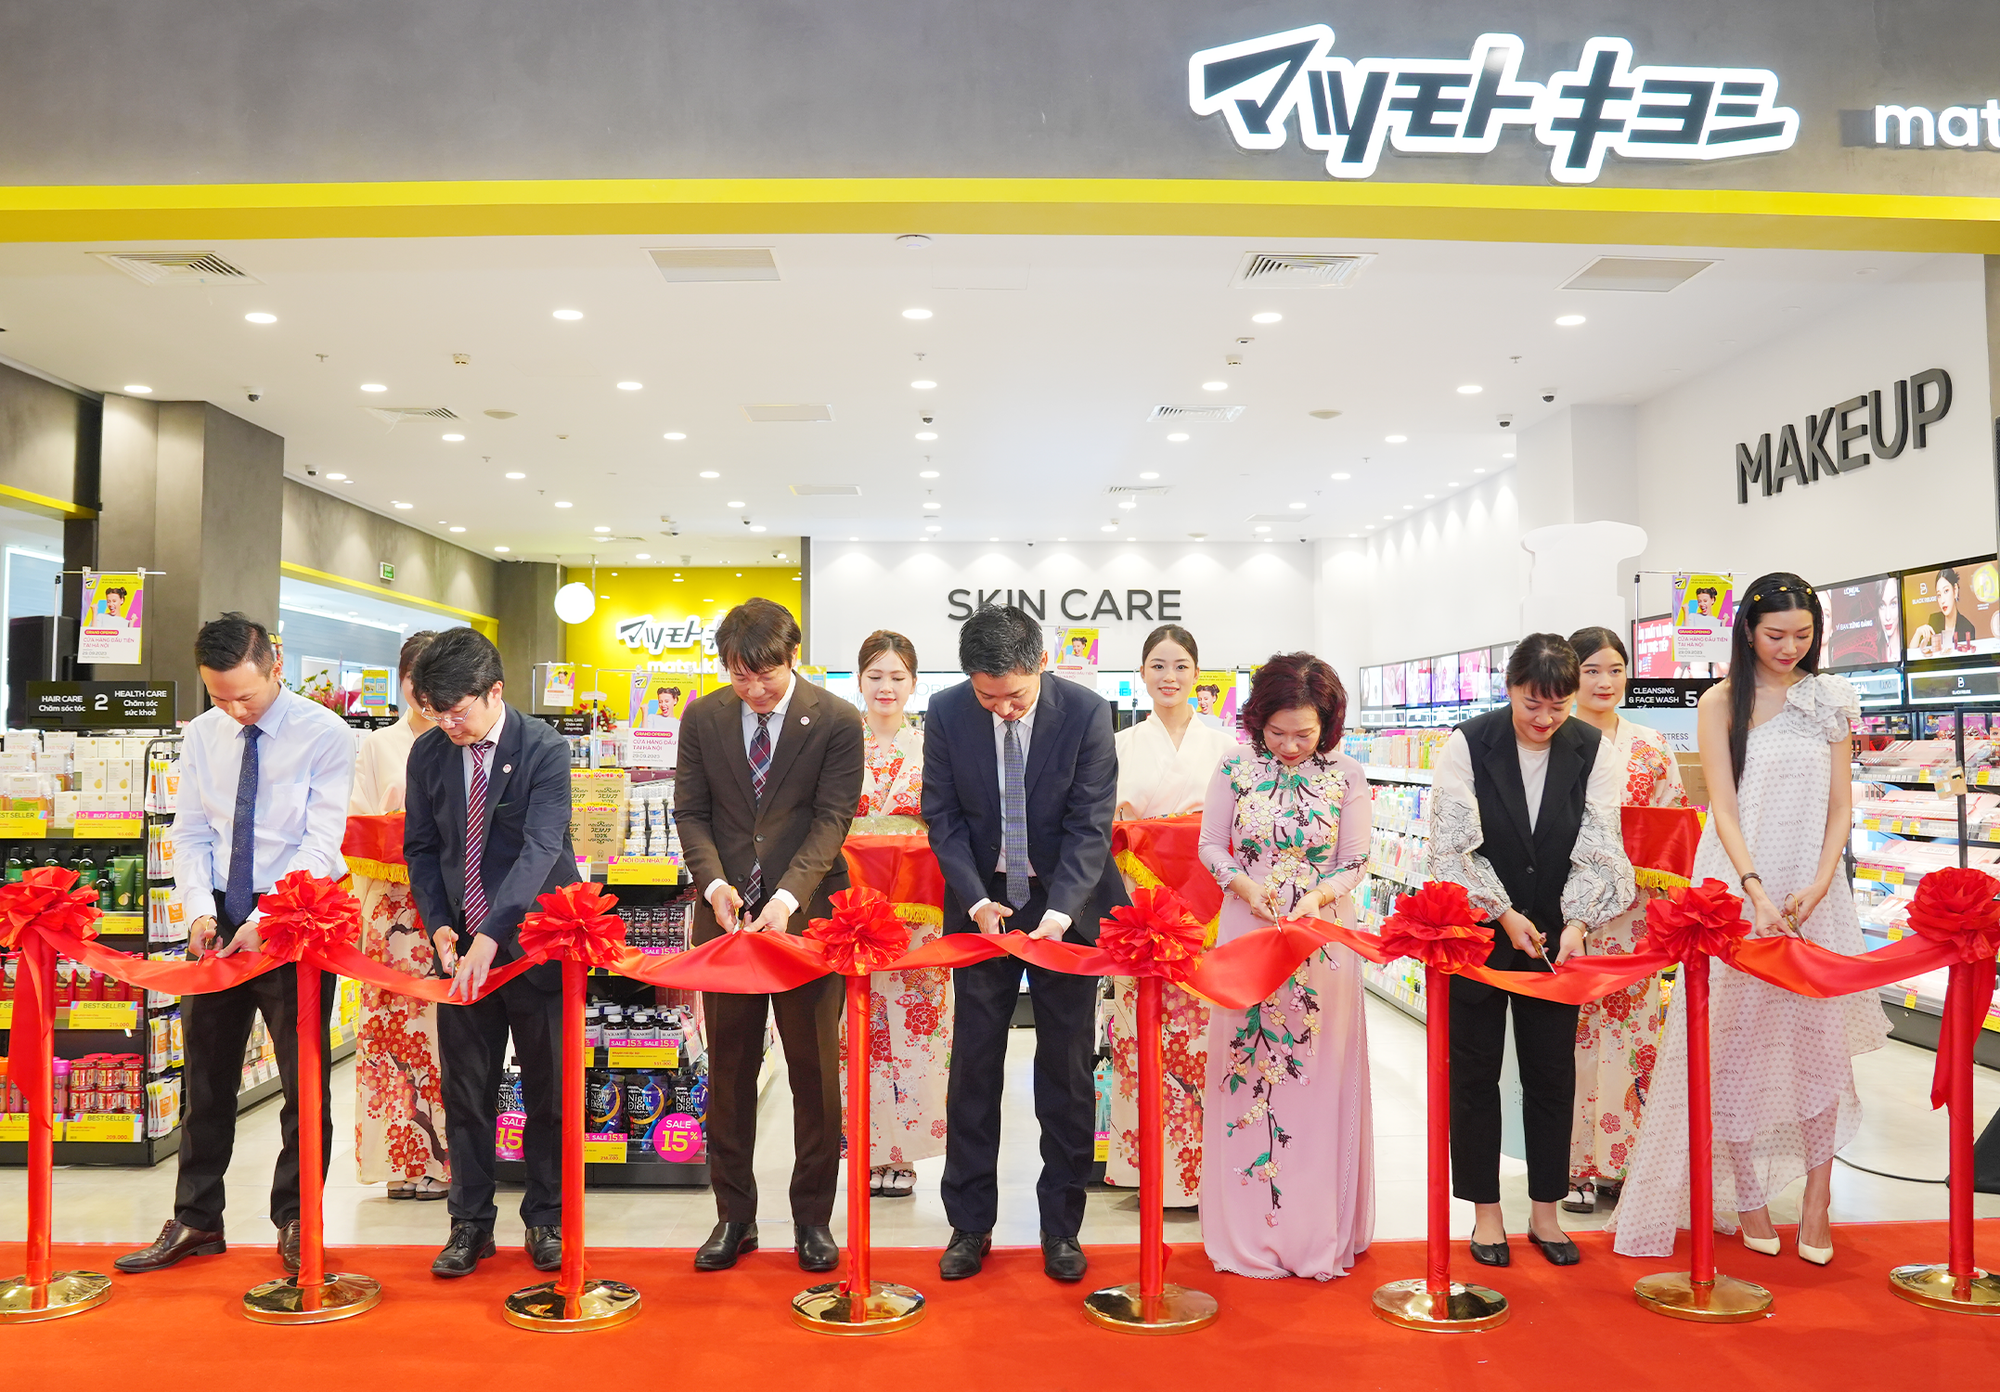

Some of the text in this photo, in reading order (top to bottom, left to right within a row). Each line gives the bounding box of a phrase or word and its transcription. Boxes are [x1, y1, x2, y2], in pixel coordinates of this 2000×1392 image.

[1194, 28, 1794, 177] マツモトキヨシ
[1875, 99, 2000, 148] mat
[1735, 367, 1953, 504] MAKEUP
[947, 589, 1182, 621] SKIN CARE
[94, 694, 108, 710] 2
[1685, 690, 1698, 707] 5
[553, 720, 559, 728] 7
[628, 1094, 652, 1106] Night
[676, 1096, 700, 1107] Night
[502, 1117, 526, 1127] SALE
[666, 1120, 691, 1129] SALE
[496, 1128, 523, 1150] 15
